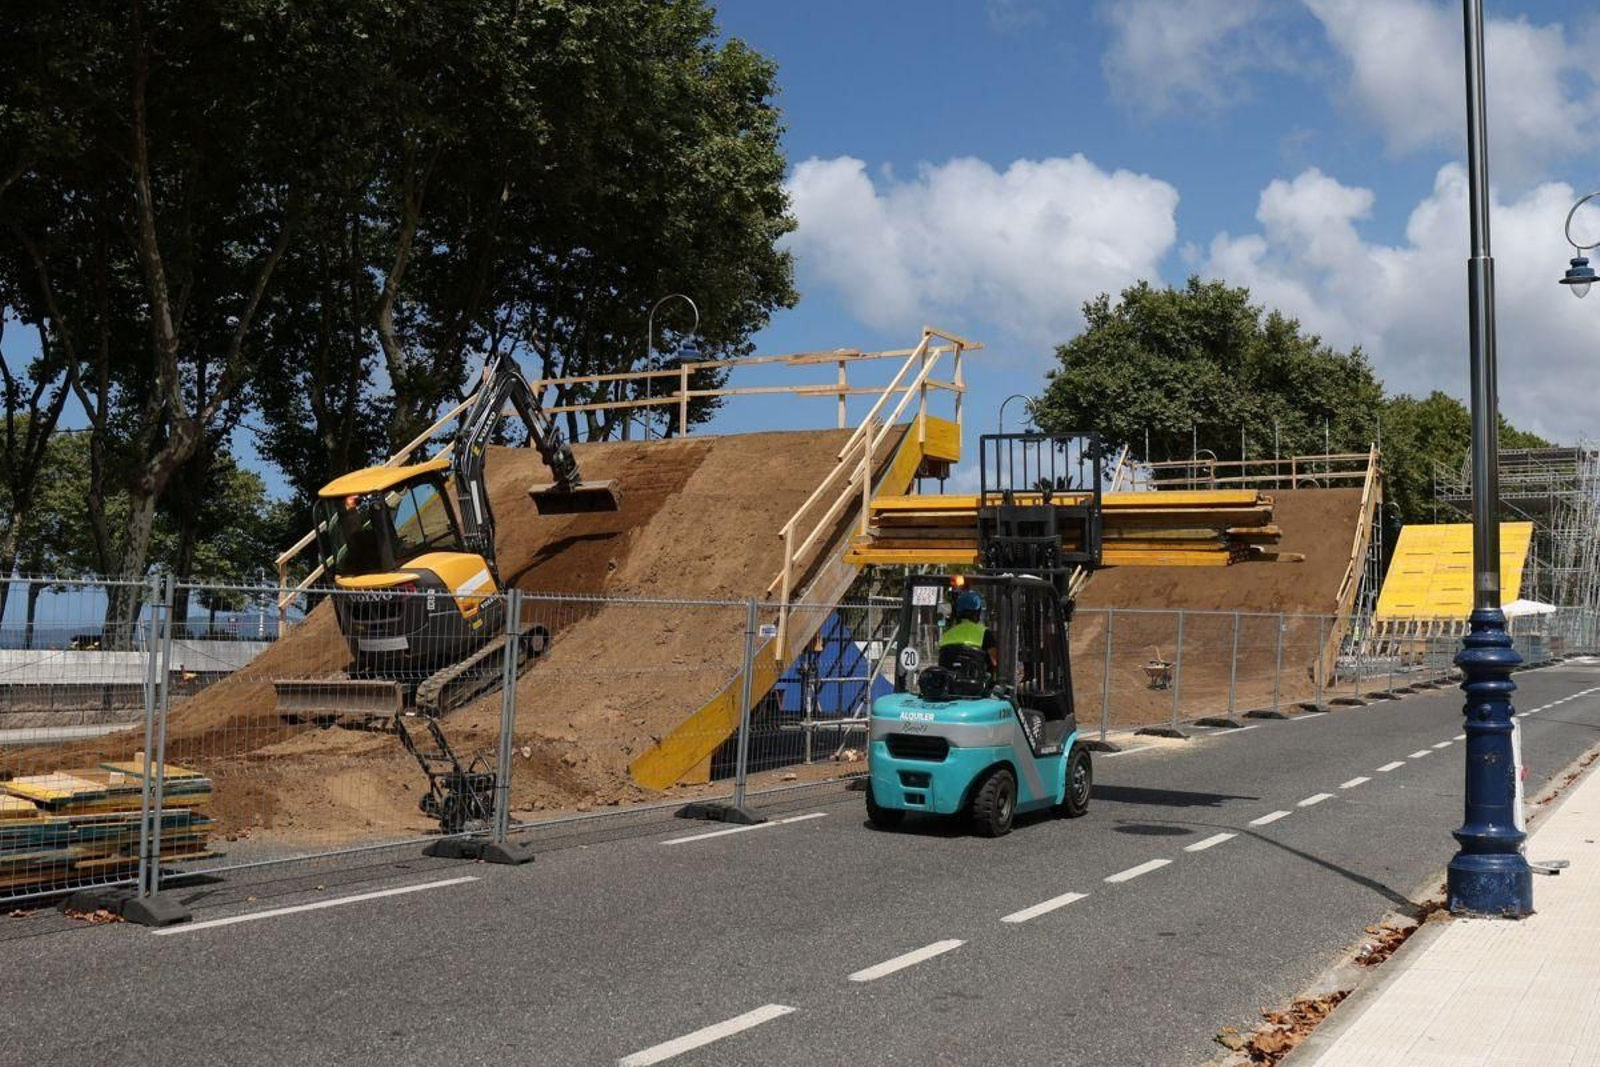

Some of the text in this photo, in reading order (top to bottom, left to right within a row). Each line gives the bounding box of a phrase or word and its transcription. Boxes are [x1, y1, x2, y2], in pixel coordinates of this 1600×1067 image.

[478, 411, 496, 442] VOLVO
[349, 593, 393, 602] VOLVO
[904, 651, 916, 666] 20
[899, 711, 935, 722] ALQUILER
